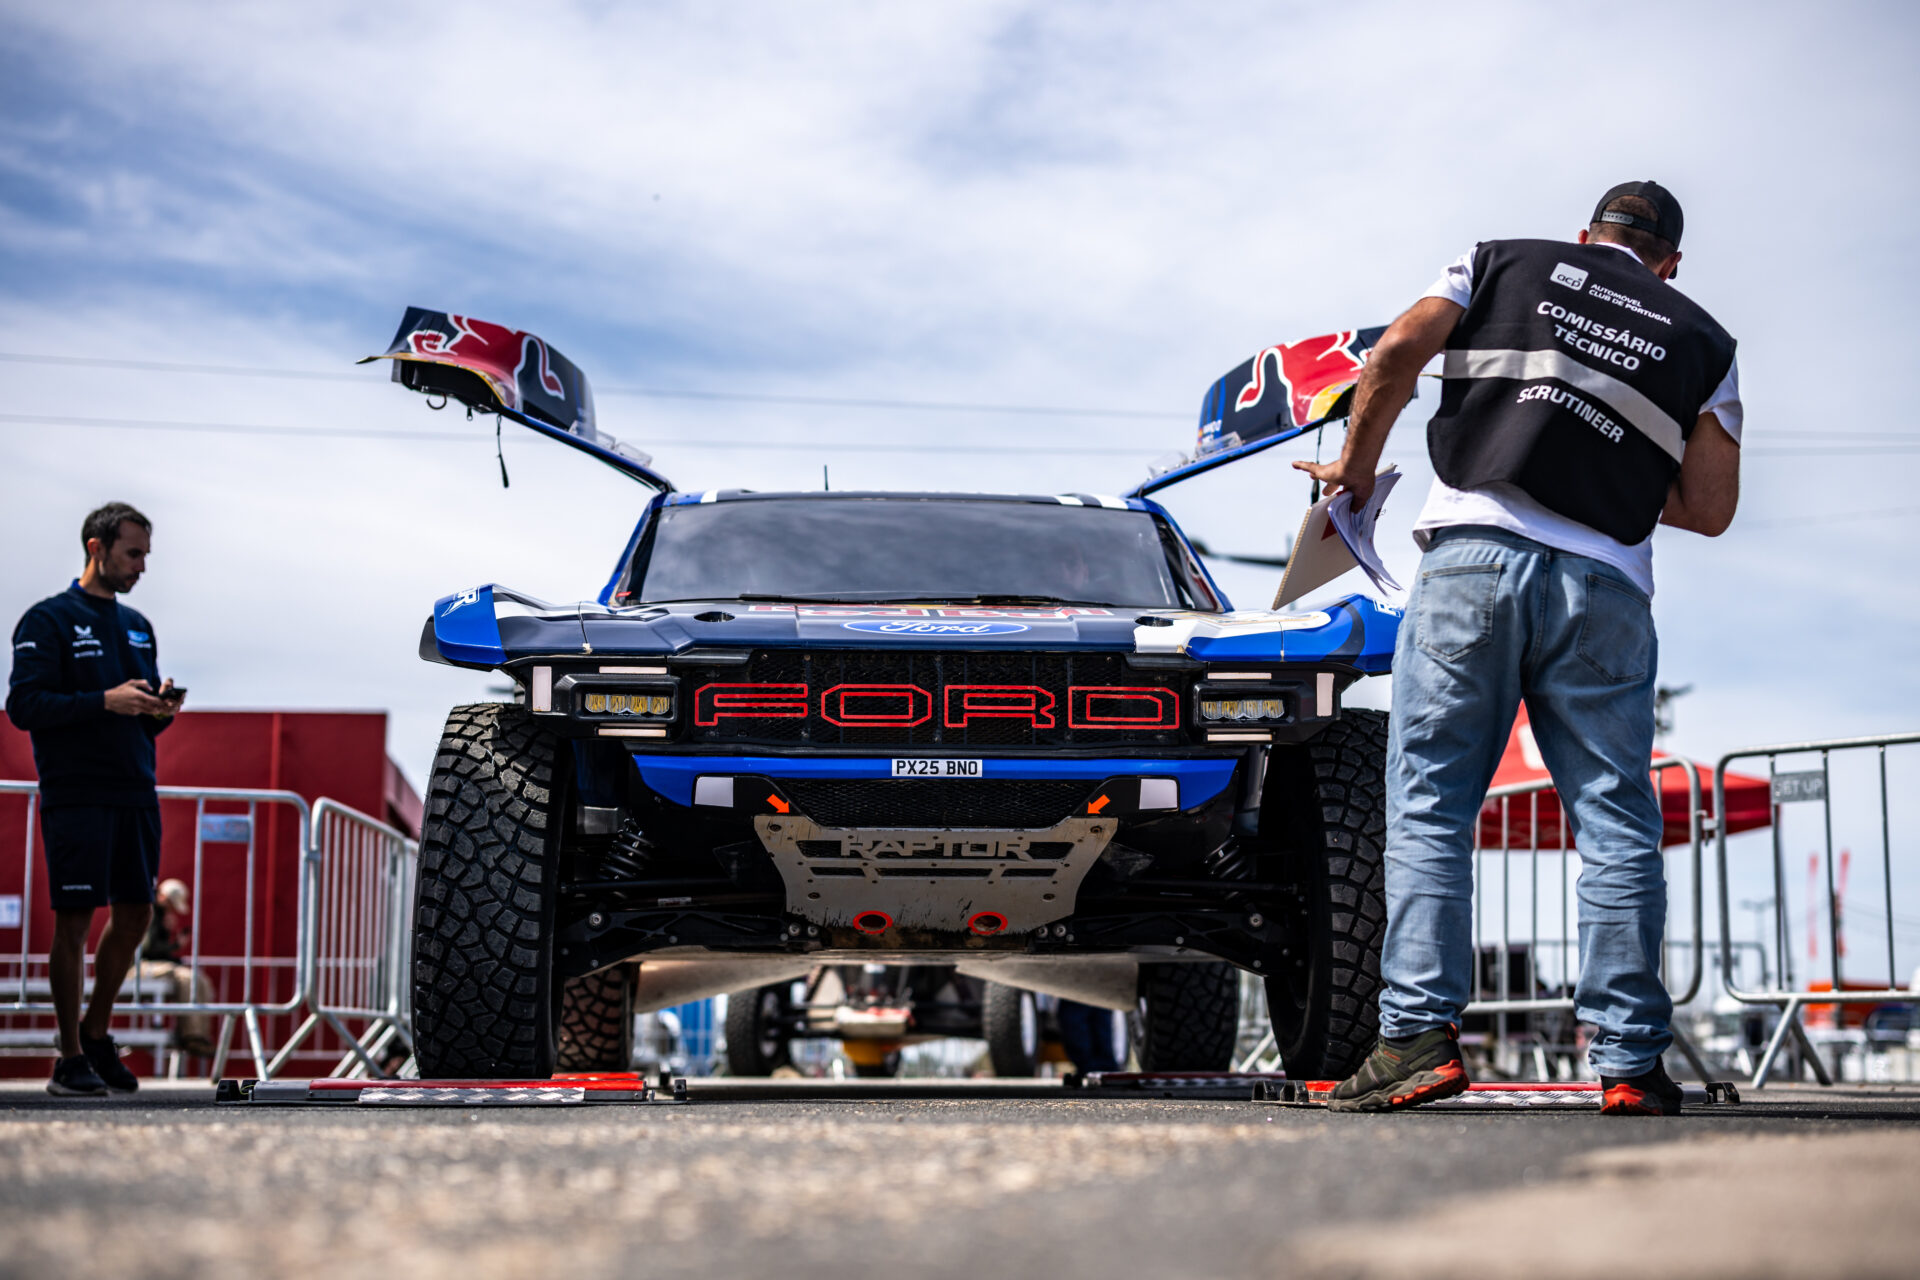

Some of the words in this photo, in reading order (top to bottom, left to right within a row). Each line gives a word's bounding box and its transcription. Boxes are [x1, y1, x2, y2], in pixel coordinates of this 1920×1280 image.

[1557, 273, 1582, 288] acp
[1590, 283, 1642, 308] AUTOMÓVEL
[1588, 289, 1611, 302] CLUB
[1611, 298, 1624, 307] DE
[1625, 303, 1672, 325] PORTUGAL
[1537, 301, 1667, 361] COMISSÁRIO
[1554, 324, 1640, 371] TÉCNICO
[1516, 385, 1625, 443] SCRUTINEER
[880, 620, 993, 633] Ford
[694, 683, 1180, 729] FORD
[896, 760, 940, 775] PX25
[946, 760, 978, 775] BNO
[840, 839, 1037, 862] RAPTOR
